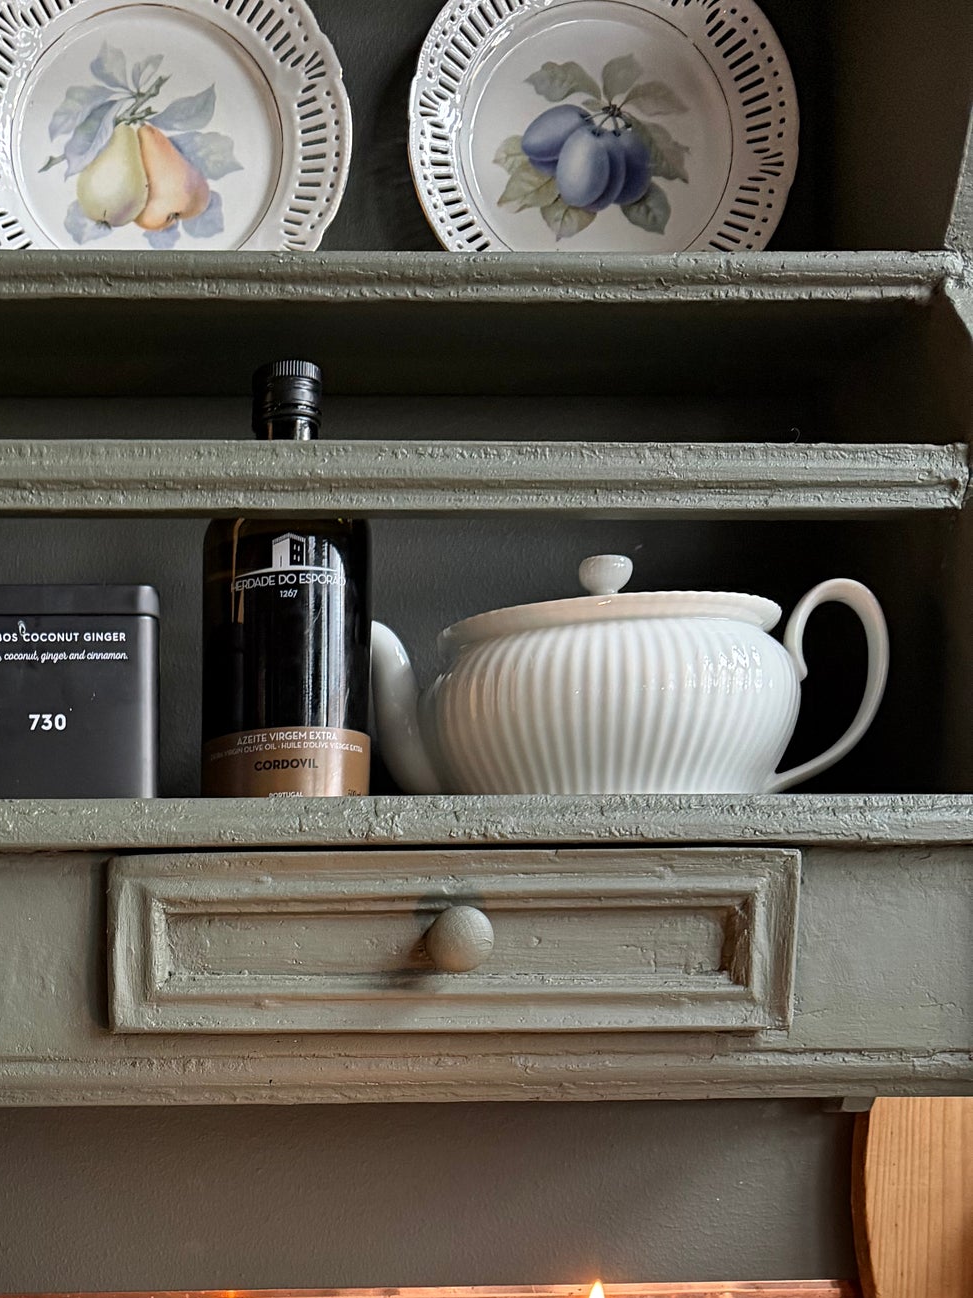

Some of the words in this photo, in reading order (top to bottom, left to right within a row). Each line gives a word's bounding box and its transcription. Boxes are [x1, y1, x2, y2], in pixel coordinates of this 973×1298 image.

[278, 573, 297, 585] DO
[279, 588, 299, 598] 1267
[22, 632, 80, 643] COCONUT
[83, 632, 127, 642] GINGER
[4, 650, 40, 662] coconut,
[40, 651, 68, 664] ginger
[68, 649, 86, 660] and
[86, 650, 129, 661] cinnamon.
[28, 713, 67, 731] 730
[236, 733, 267, 746] AZEITE
[269, 731, 307, 742] VIRGEM
[309, 731, 338, 740] EXTRA
[264, 743, 277, 751] OIL
[254, 758, 318, 772] CORDOVIL
